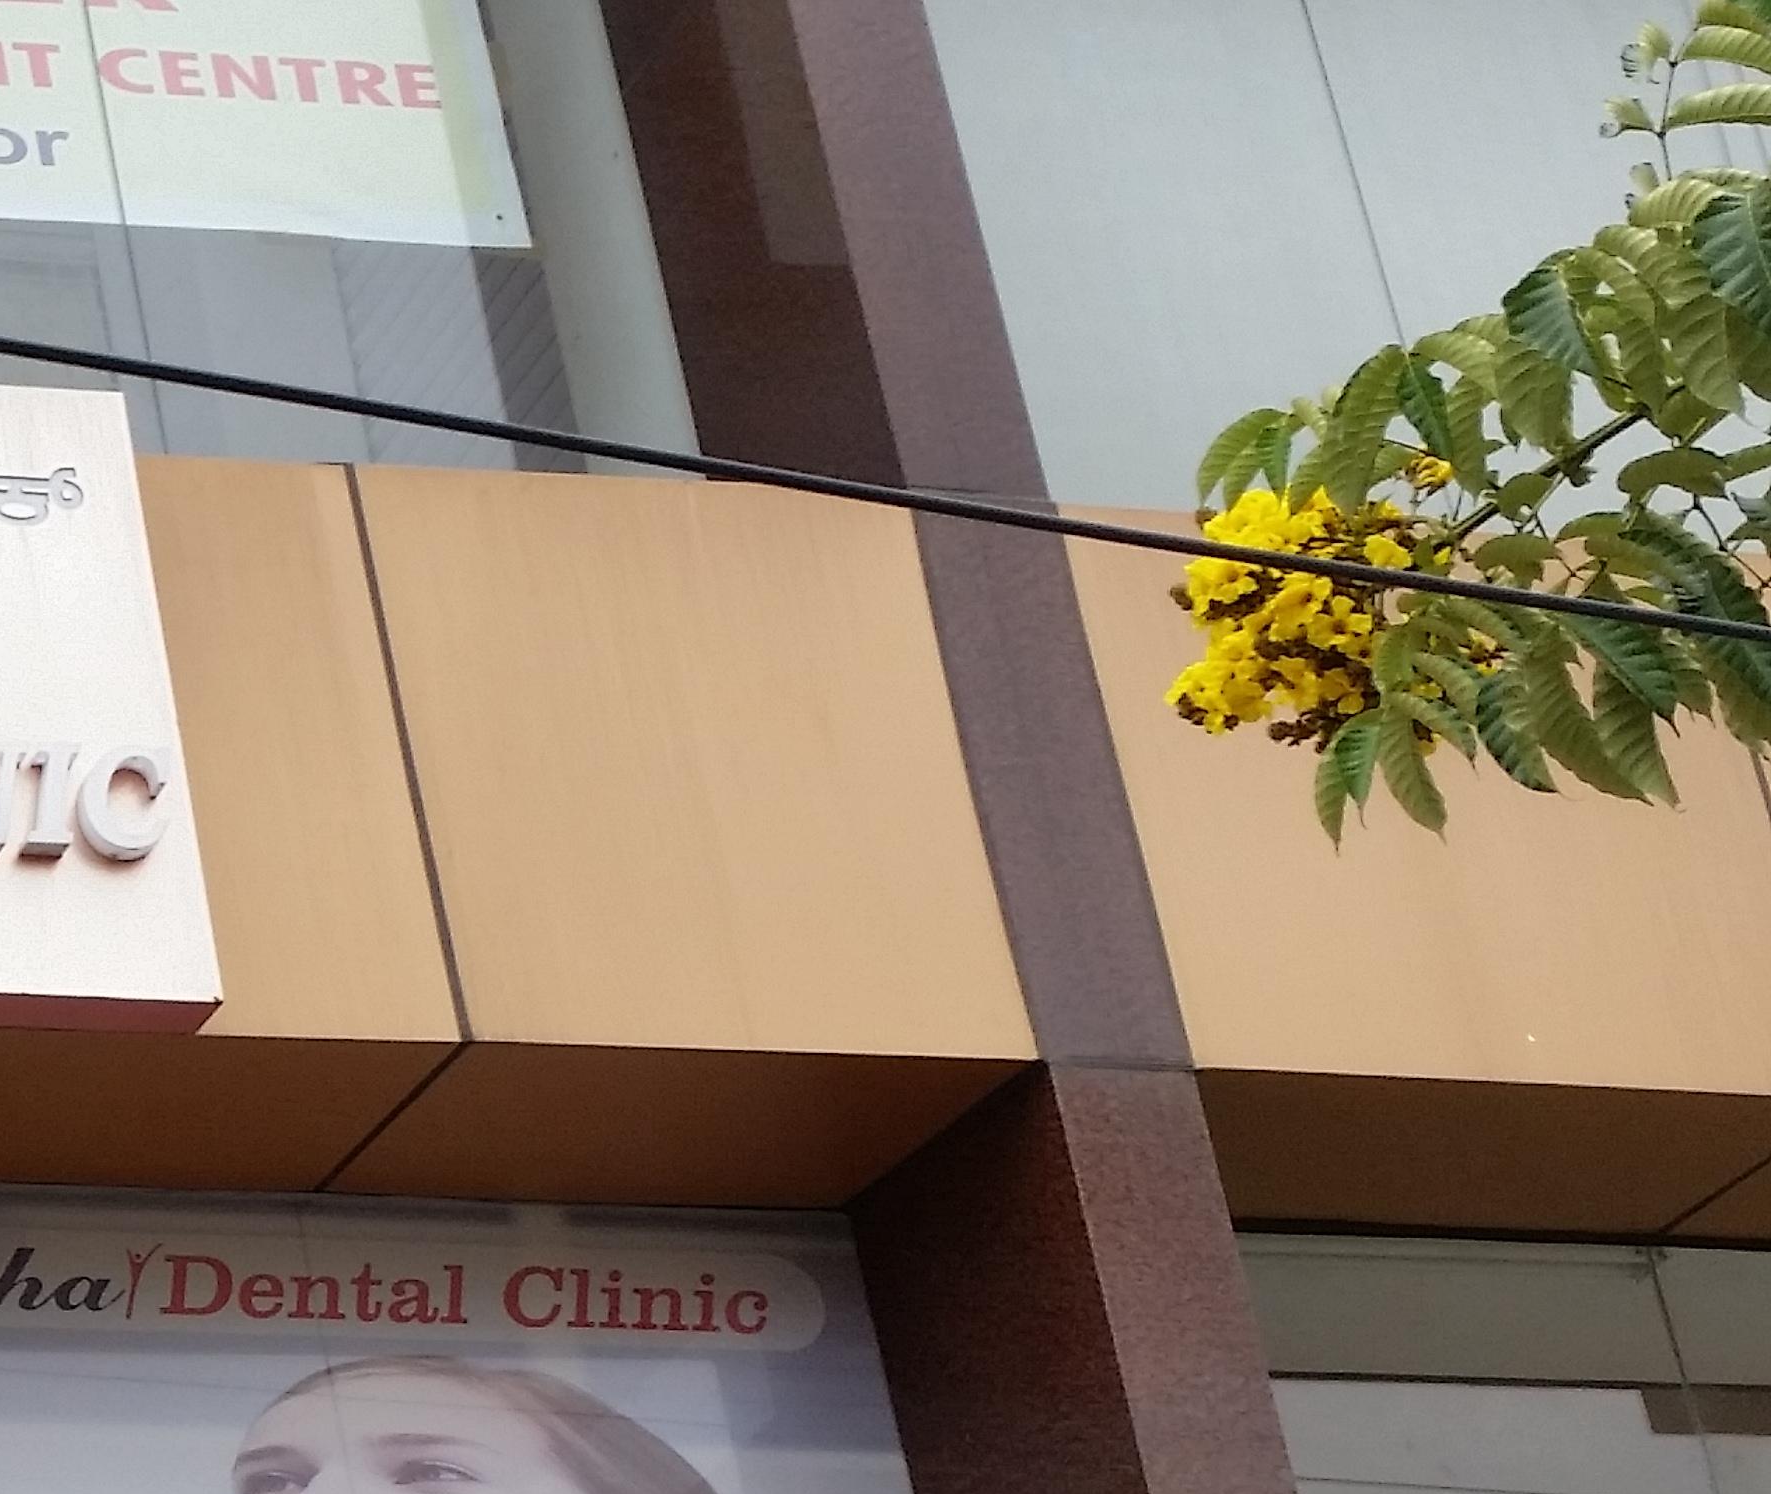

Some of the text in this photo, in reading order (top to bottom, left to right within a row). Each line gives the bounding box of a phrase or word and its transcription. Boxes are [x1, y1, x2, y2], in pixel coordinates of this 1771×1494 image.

[100, 49, 442, 109] CENTRE
[159, 1253, 469, 1328] Dental
[501, 1265, 770, 1335] Clinic
